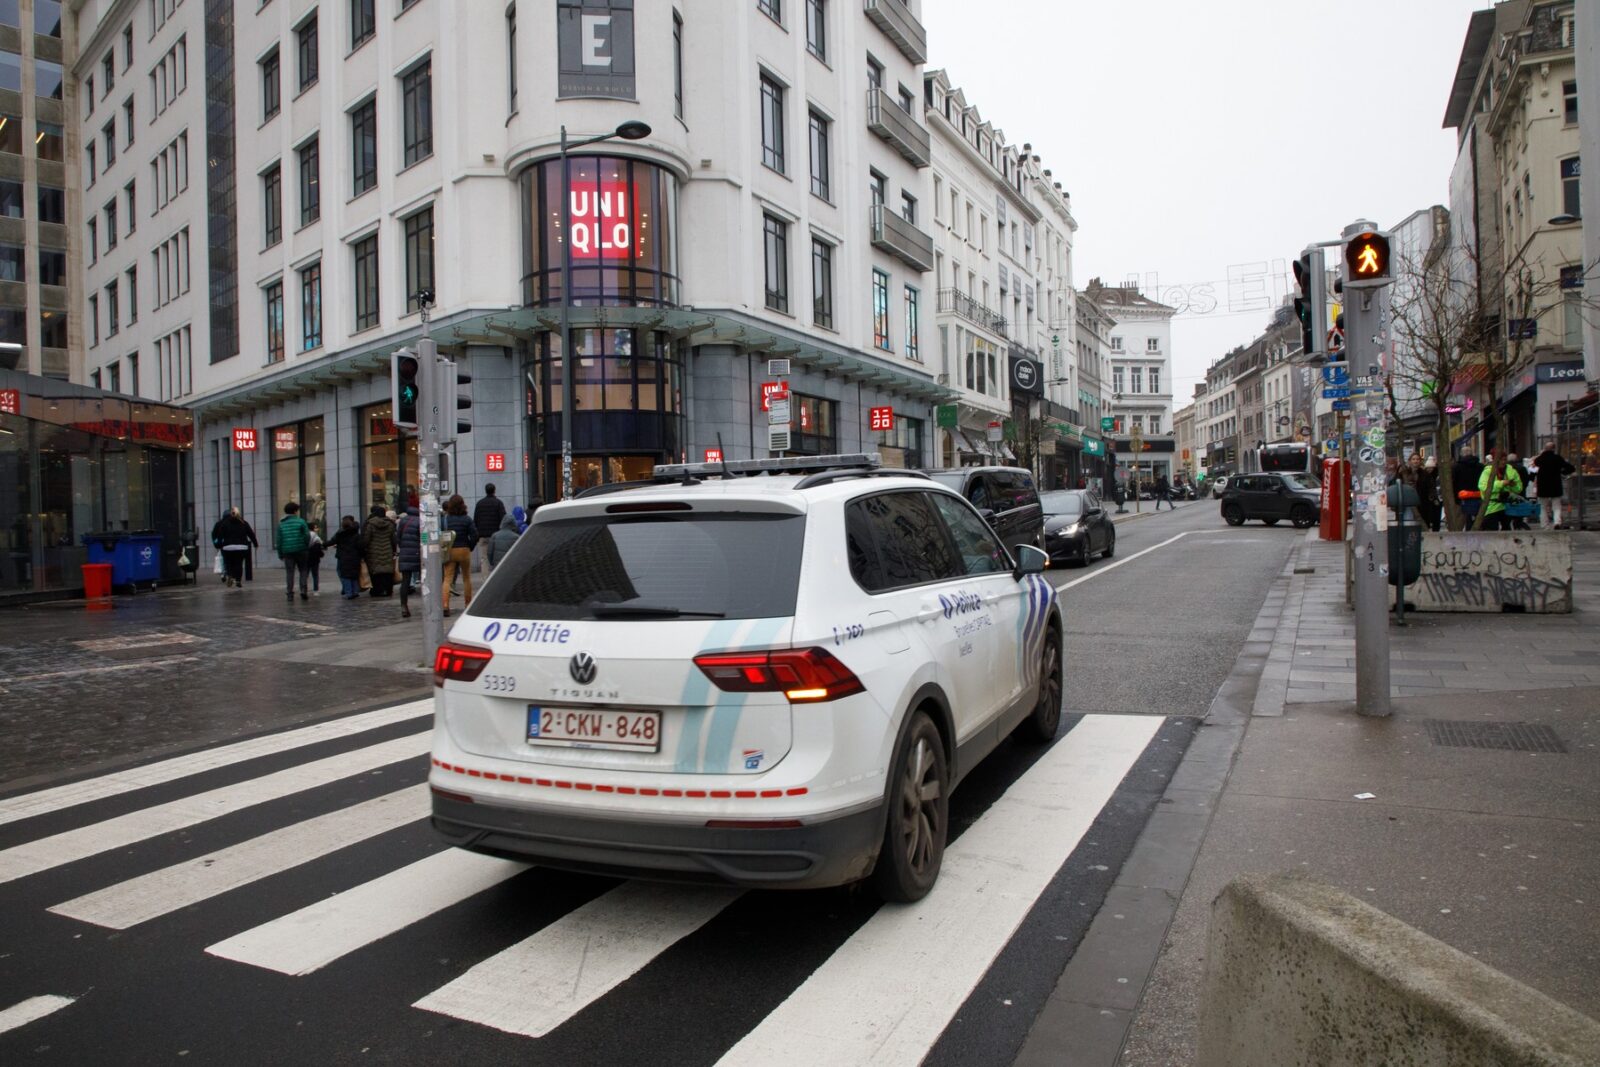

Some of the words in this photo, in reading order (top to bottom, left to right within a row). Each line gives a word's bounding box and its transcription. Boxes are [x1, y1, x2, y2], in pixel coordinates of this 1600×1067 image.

[581, 14, 612, 66] E
[571, 191, 625, 217] UNI
[571, 222, 629, 253] QLO
[235, 430, 253, 440] UNI
[236, 440, 255, 450] QLO
[950, 590, 982, 616] Police
[504, 622, 570, 644] Politie
[484, 674, 516, 692] 5339
